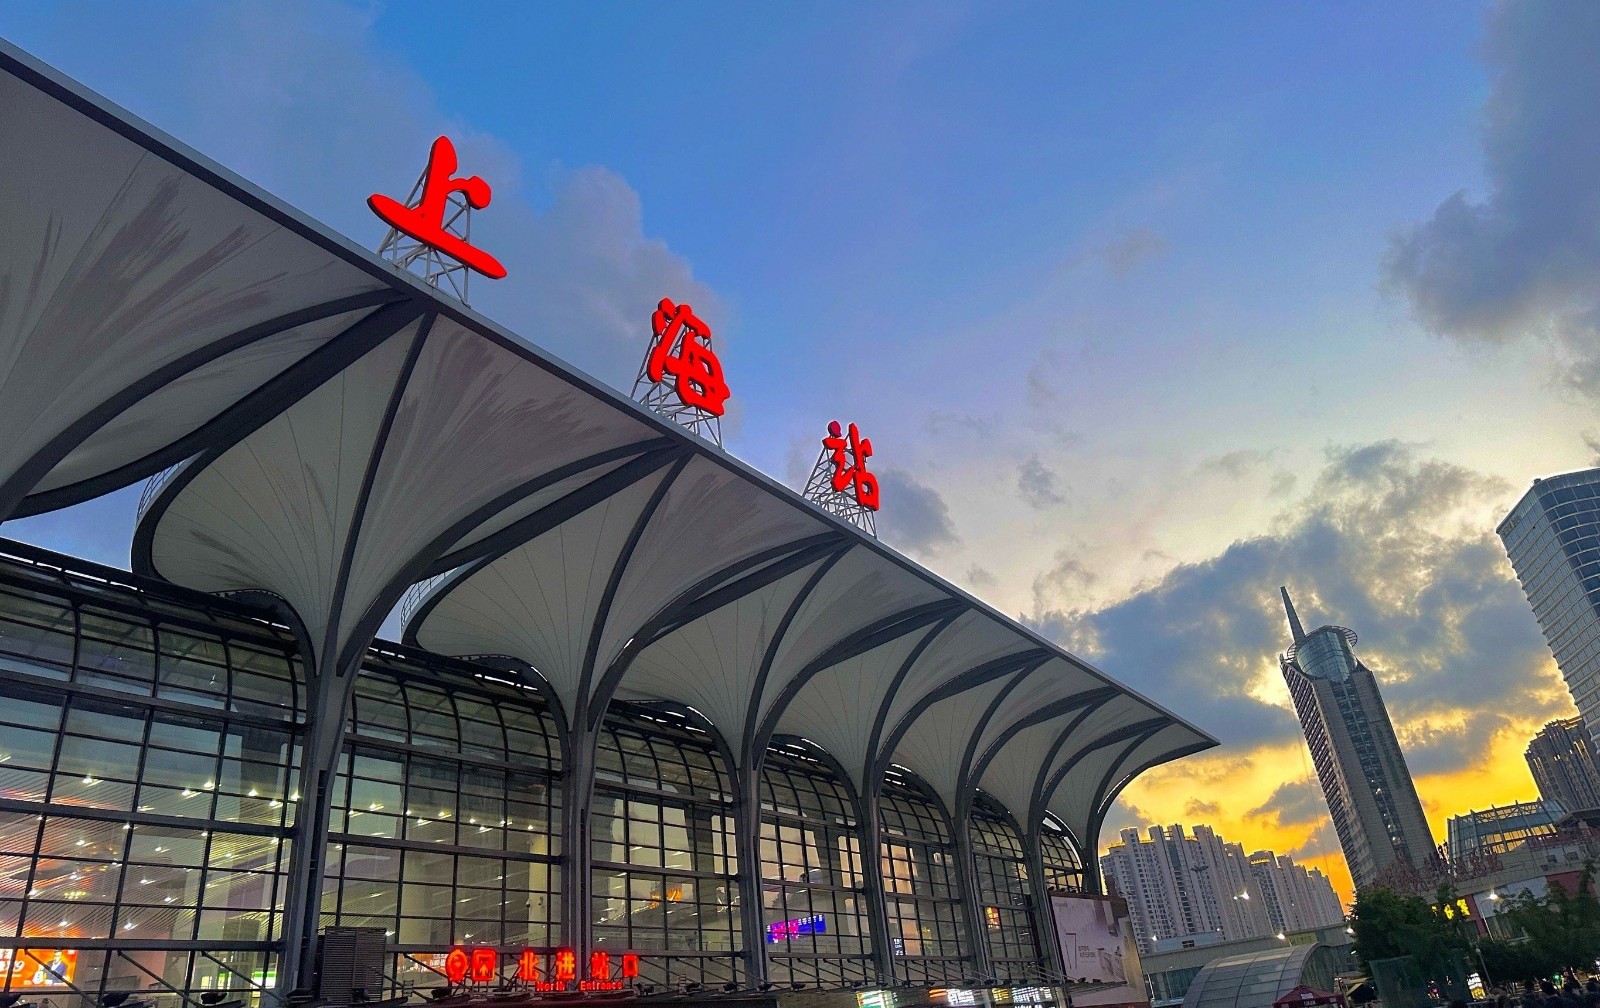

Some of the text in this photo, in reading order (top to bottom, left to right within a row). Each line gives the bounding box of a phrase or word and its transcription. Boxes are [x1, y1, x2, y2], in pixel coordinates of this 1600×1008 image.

[367, 136, 880, 511] 上海站
[518, 951, 639, 981] 北进站口
[536, 980, 623, 992] North Entrance
